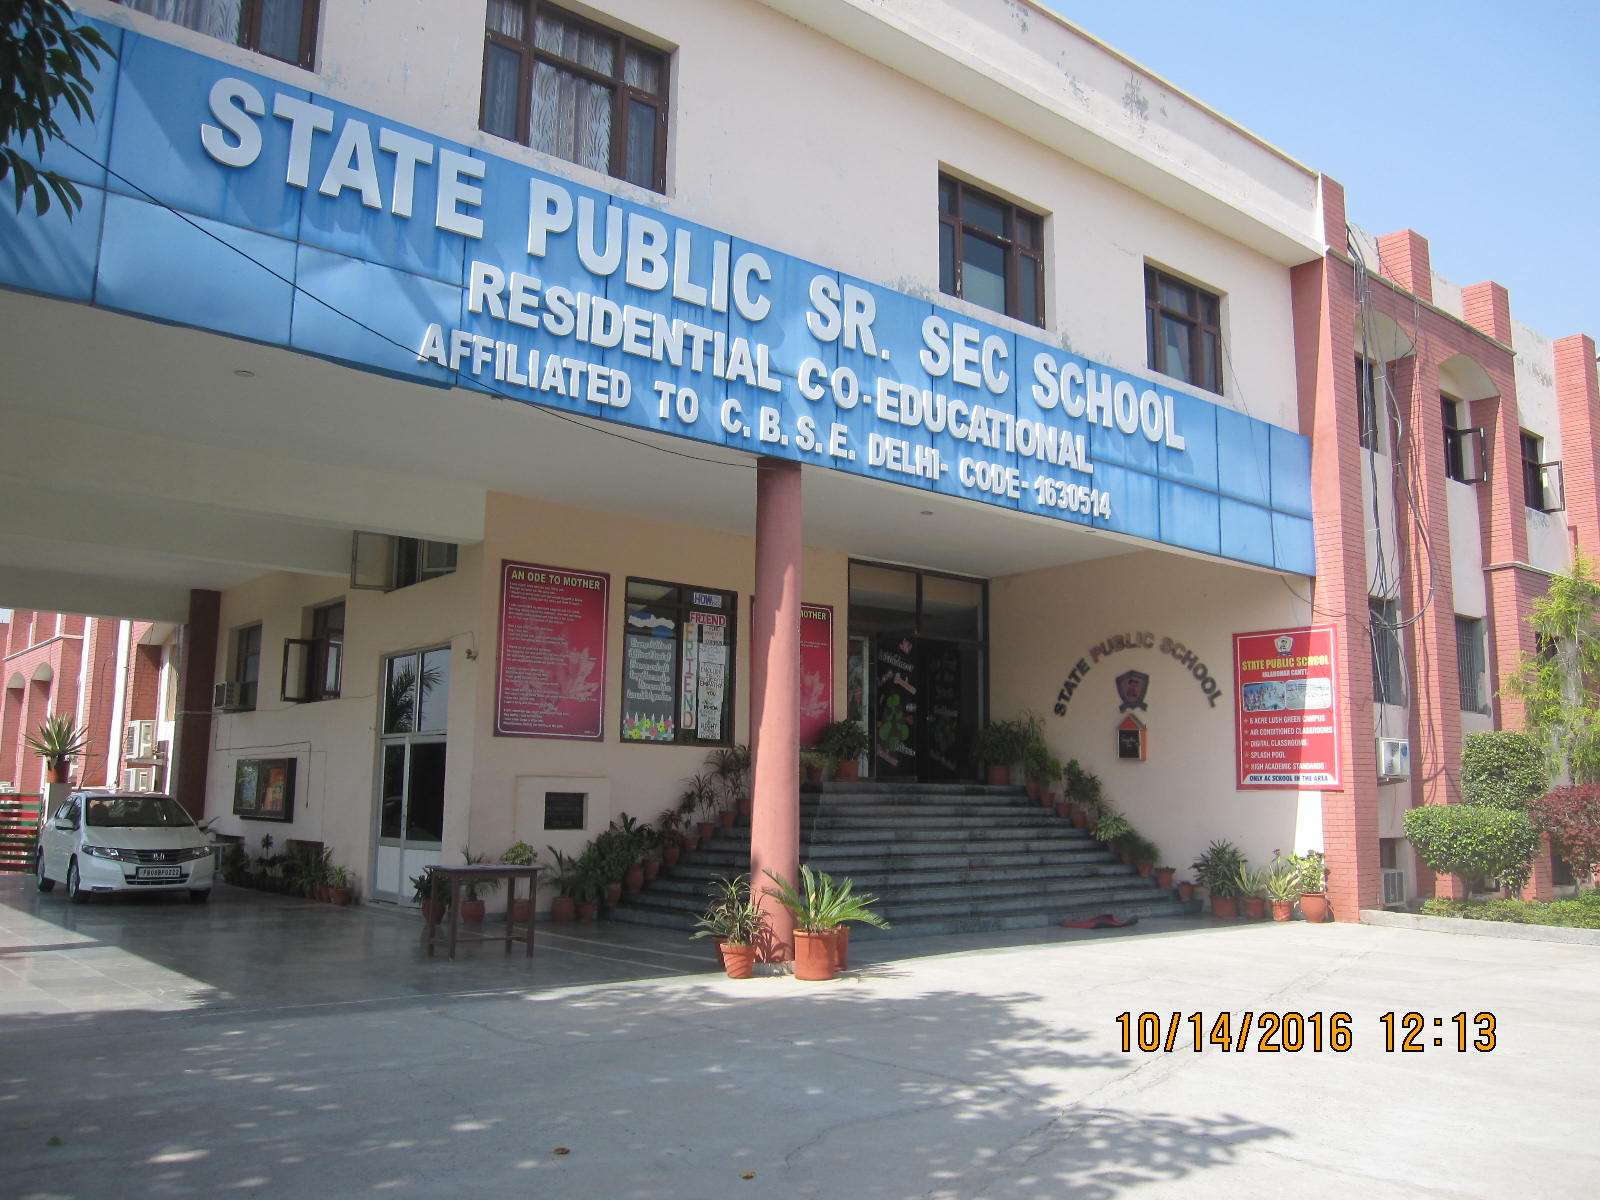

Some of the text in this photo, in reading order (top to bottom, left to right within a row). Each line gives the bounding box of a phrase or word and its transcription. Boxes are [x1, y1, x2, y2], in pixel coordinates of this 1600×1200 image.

[201, 78, 1186, 451] STATE PUBLIC SR. SEC SCHOOL
[468, 260, 783, 393] RESIDENTIAL
[417, 322, 632, 409] AFFILIATED
[654, 380, 700, 424] TO
[1034, 475, 1112, 520] 1630514
[511, 570, 600, 589] AN ODE TO MOTHER
[690, 612, 726, 626] FRIEND
[1054, 631, 1223, 718] STATE PUBLIC SCHOOL
[1242, 660, 1265, 671] STATE
[1266, 657, 1294, 669] PUBLIC
